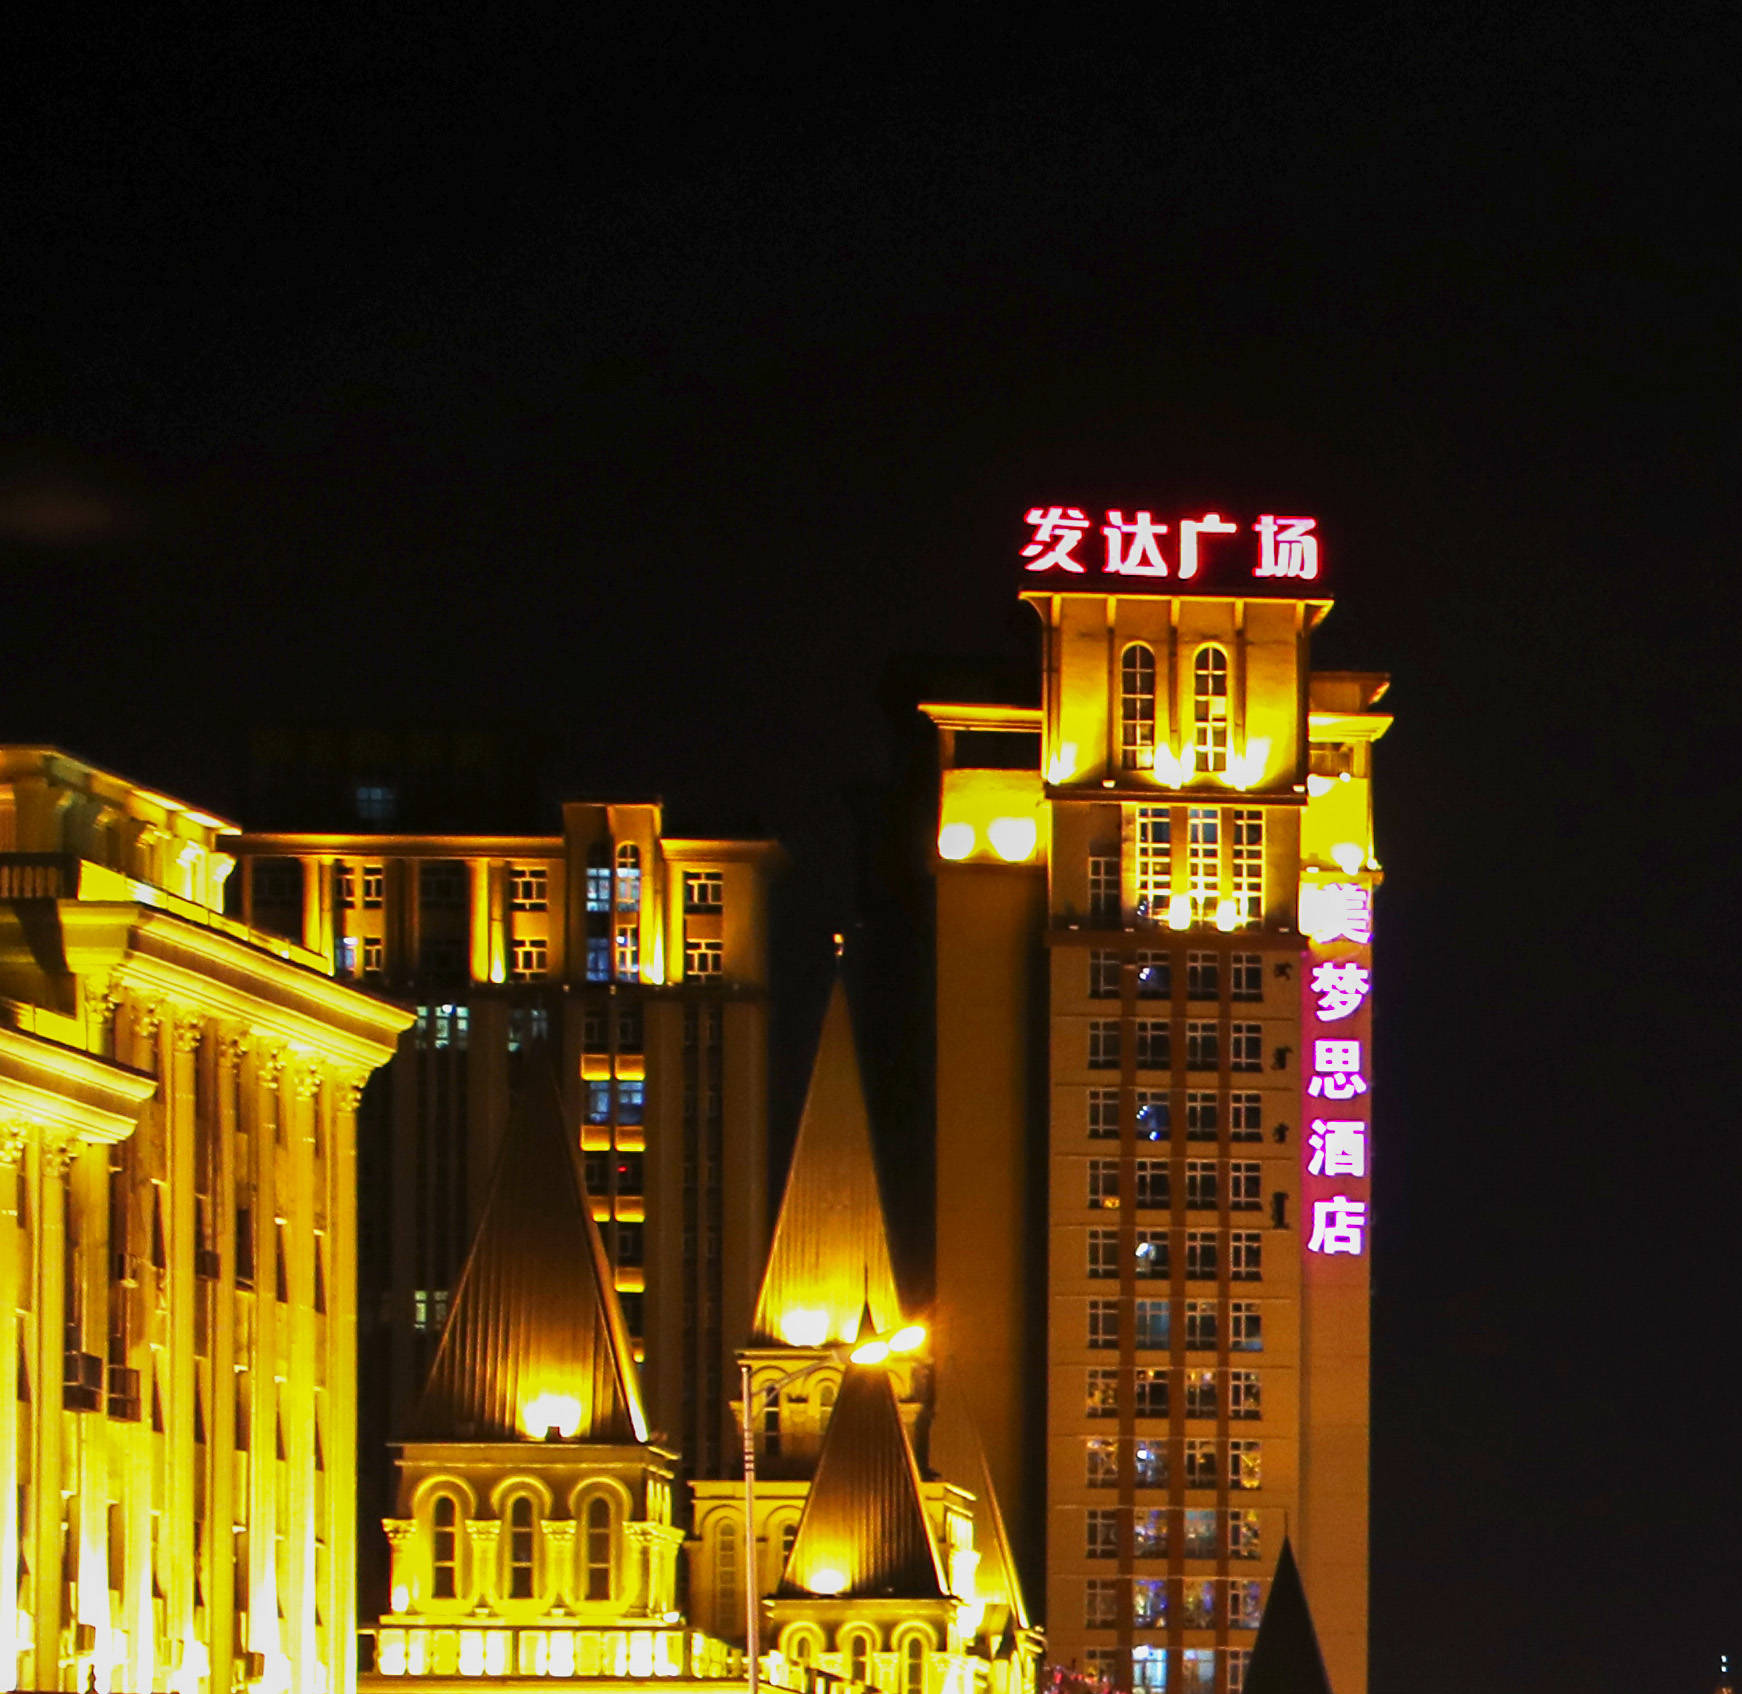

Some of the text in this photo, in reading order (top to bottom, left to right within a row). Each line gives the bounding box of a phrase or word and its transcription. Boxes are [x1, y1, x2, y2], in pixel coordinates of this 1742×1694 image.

[1020, 507, 1319, 580] 发达广场
[1308, 883, 1373, 1256] 美梦思酒店
